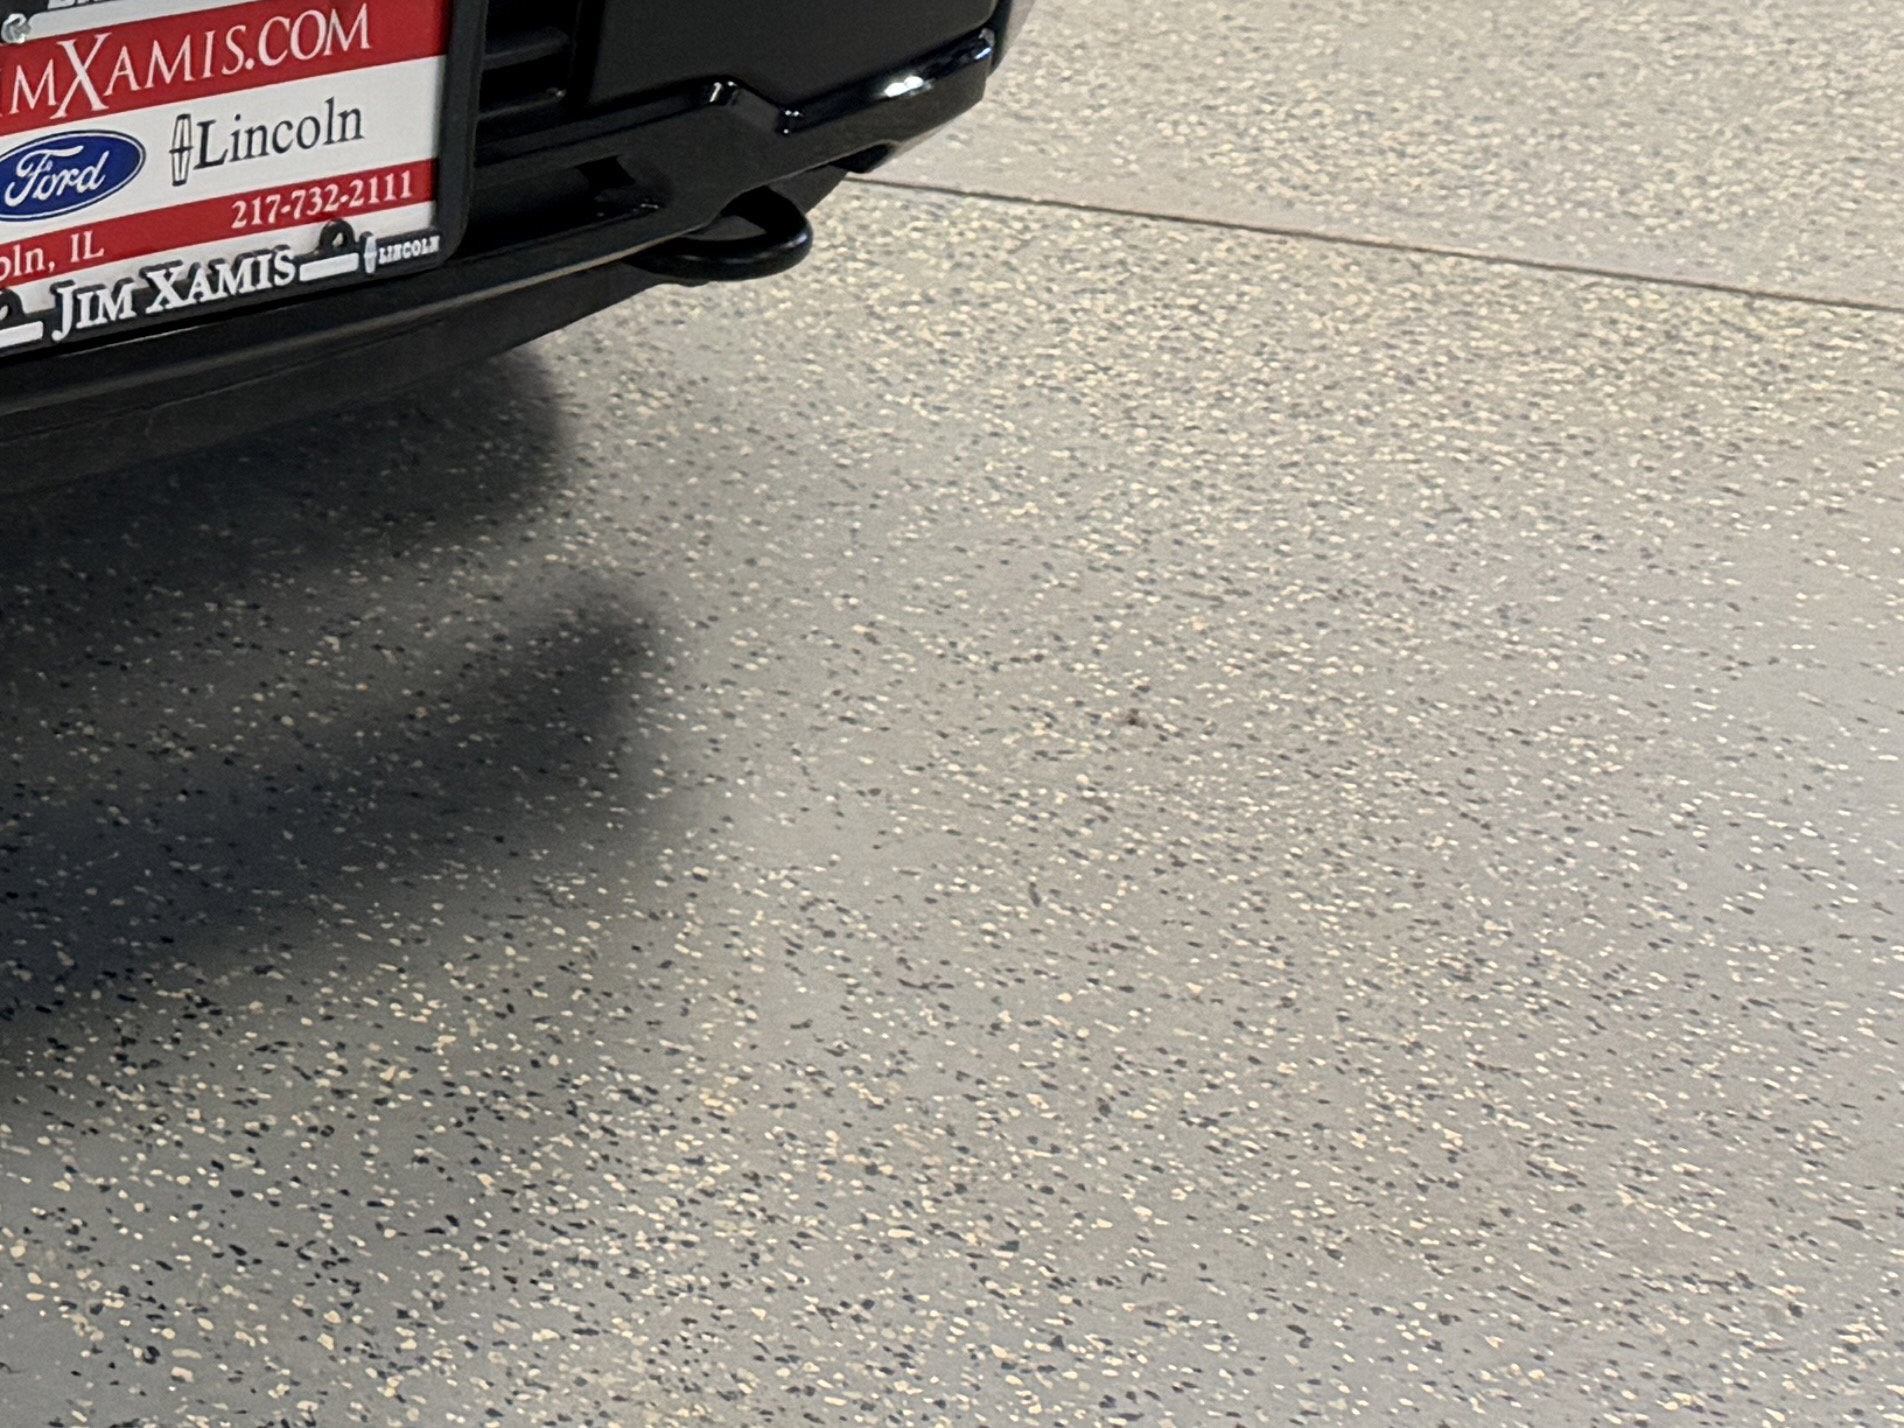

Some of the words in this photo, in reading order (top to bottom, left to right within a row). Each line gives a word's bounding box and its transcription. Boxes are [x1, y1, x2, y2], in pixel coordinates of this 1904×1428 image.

[193, 96, 364, 171] Lincoln
[4, 145, 106, 207] Ford
[230, 170, 412, 230] 217-732-2111
[70, 230, 105, 263] IL
[378, 235, 441, 265] LINCOLN
[51, 282, 137, 342] JIM
[145, 248, 296, 313] XAMIS
